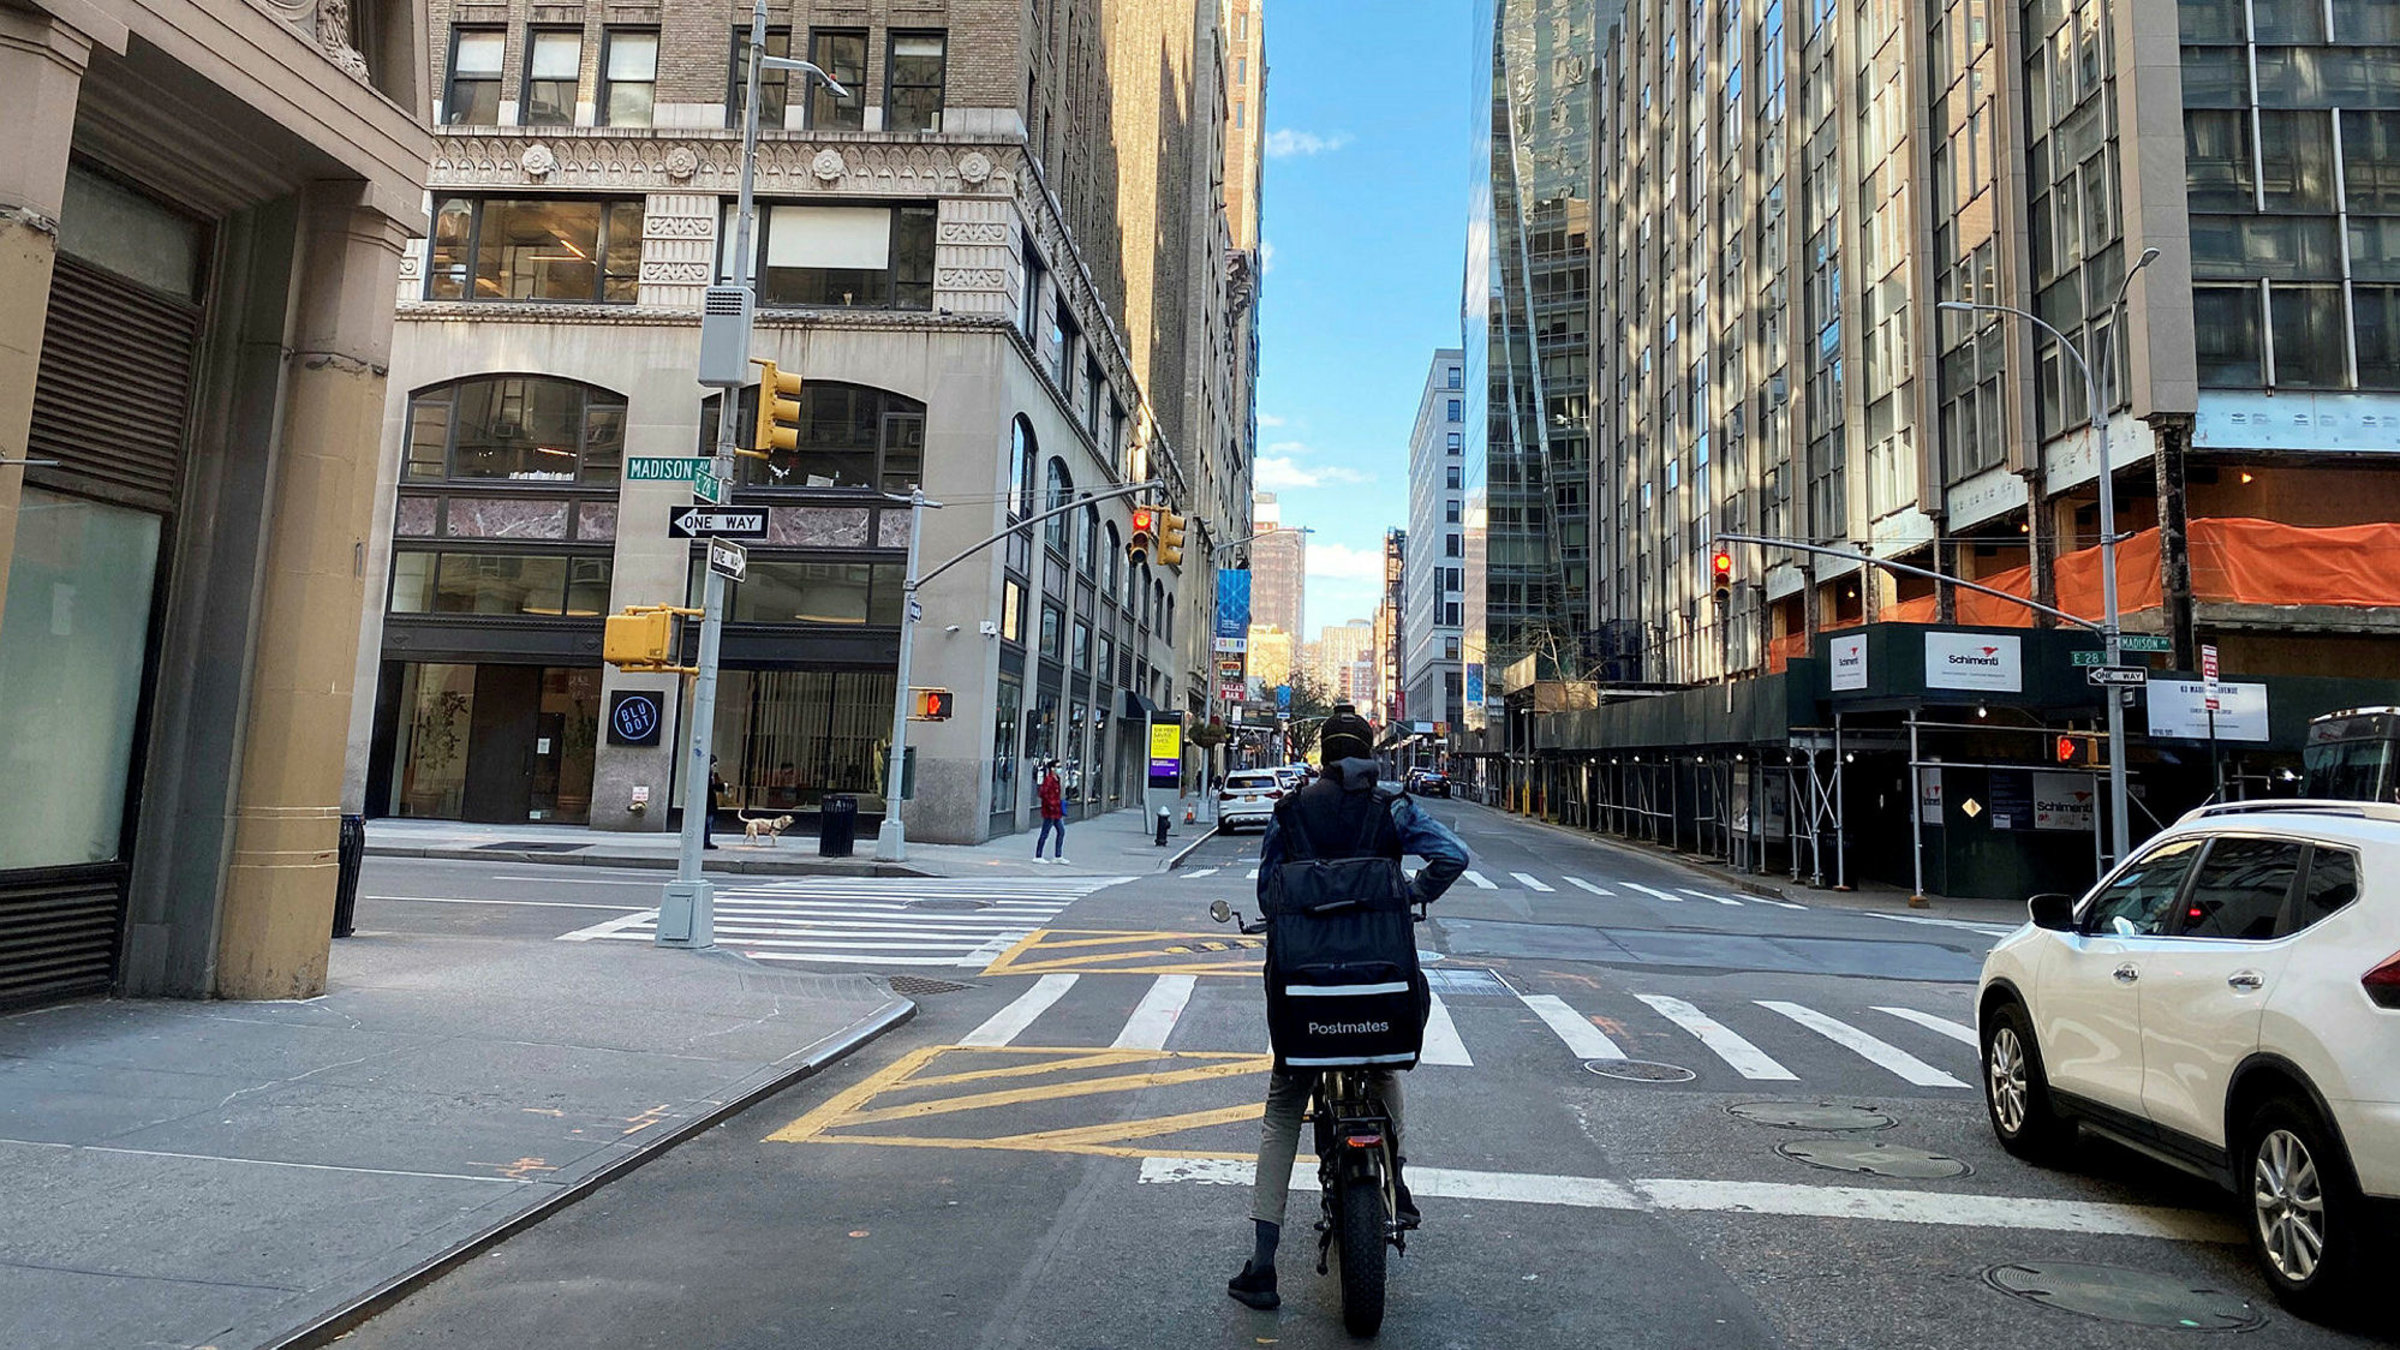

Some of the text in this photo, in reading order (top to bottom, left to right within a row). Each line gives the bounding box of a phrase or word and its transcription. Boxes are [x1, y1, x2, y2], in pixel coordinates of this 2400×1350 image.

[630, 459, 710, 479] MADISON AV
[696, 473, 701, 491] E
[702, 477, 711, 497] 28
[684, 516, 757, 529] ONE WAY
[714, 548, 726, 563] ONE
[2122, 638, 2158, 649] MADISON
[1948, 655, 1999, 667] Schimenti
[2073, 654, 2080, 664] E
[2085, 653, 2100, 664] 28
[2123, 672, 2141, 680] WAY
[621, 702, 646, 722] BLU
[625, 715, 650, 734] DOT
[2037, 801, 2093, 813] Schimenti
[1308, 1020, 1390, 1035] Postmates
